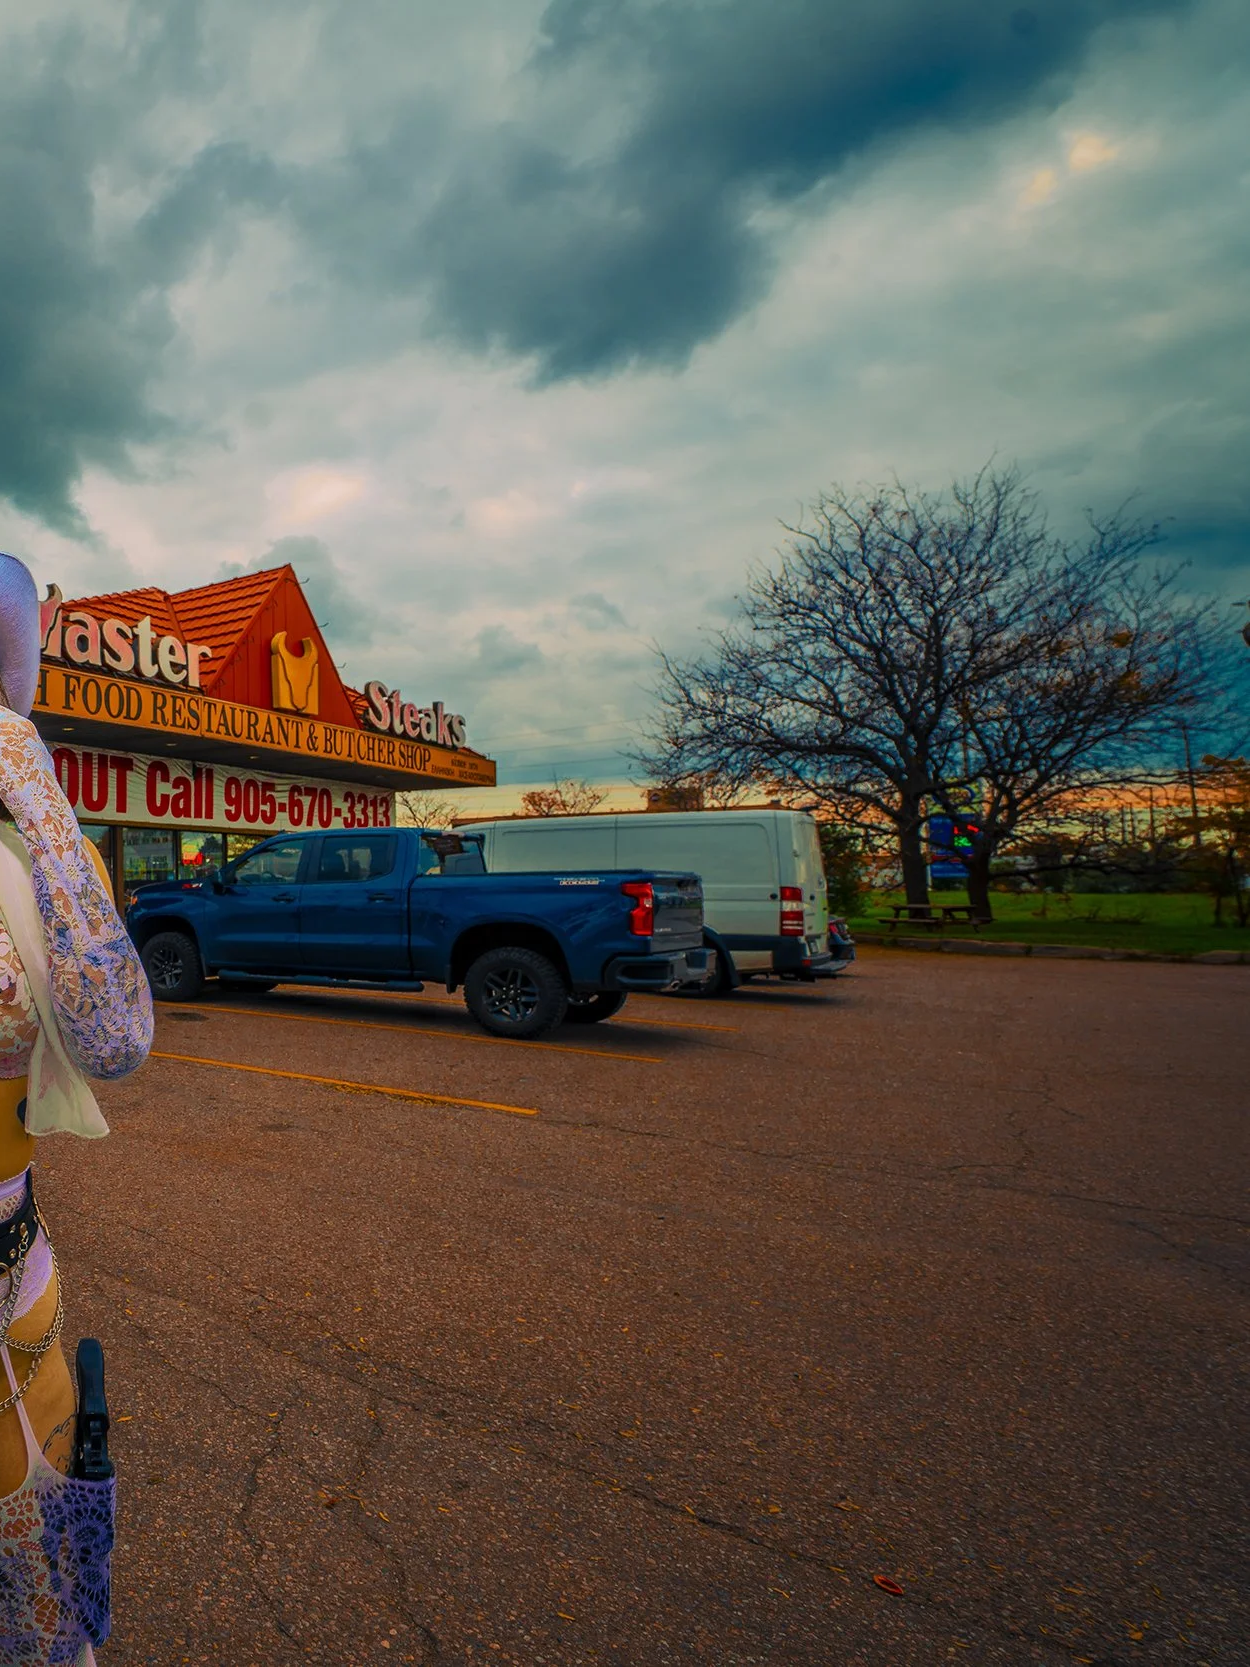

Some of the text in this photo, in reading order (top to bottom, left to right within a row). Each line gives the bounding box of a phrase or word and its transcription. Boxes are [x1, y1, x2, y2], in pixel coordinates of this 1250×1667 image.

[62, 673, 142, 722] FOOD
[150, 691, 303, 749] RESTAURANT
[306, 724, 319, 751] &
[323, 726, 397, 765] BUTCHER
[398, 744, 431, 772] SHOP
[364, 680, 466, 748] Steaks
[52, 748, 391, 829] OUT Call 905-670-3313
